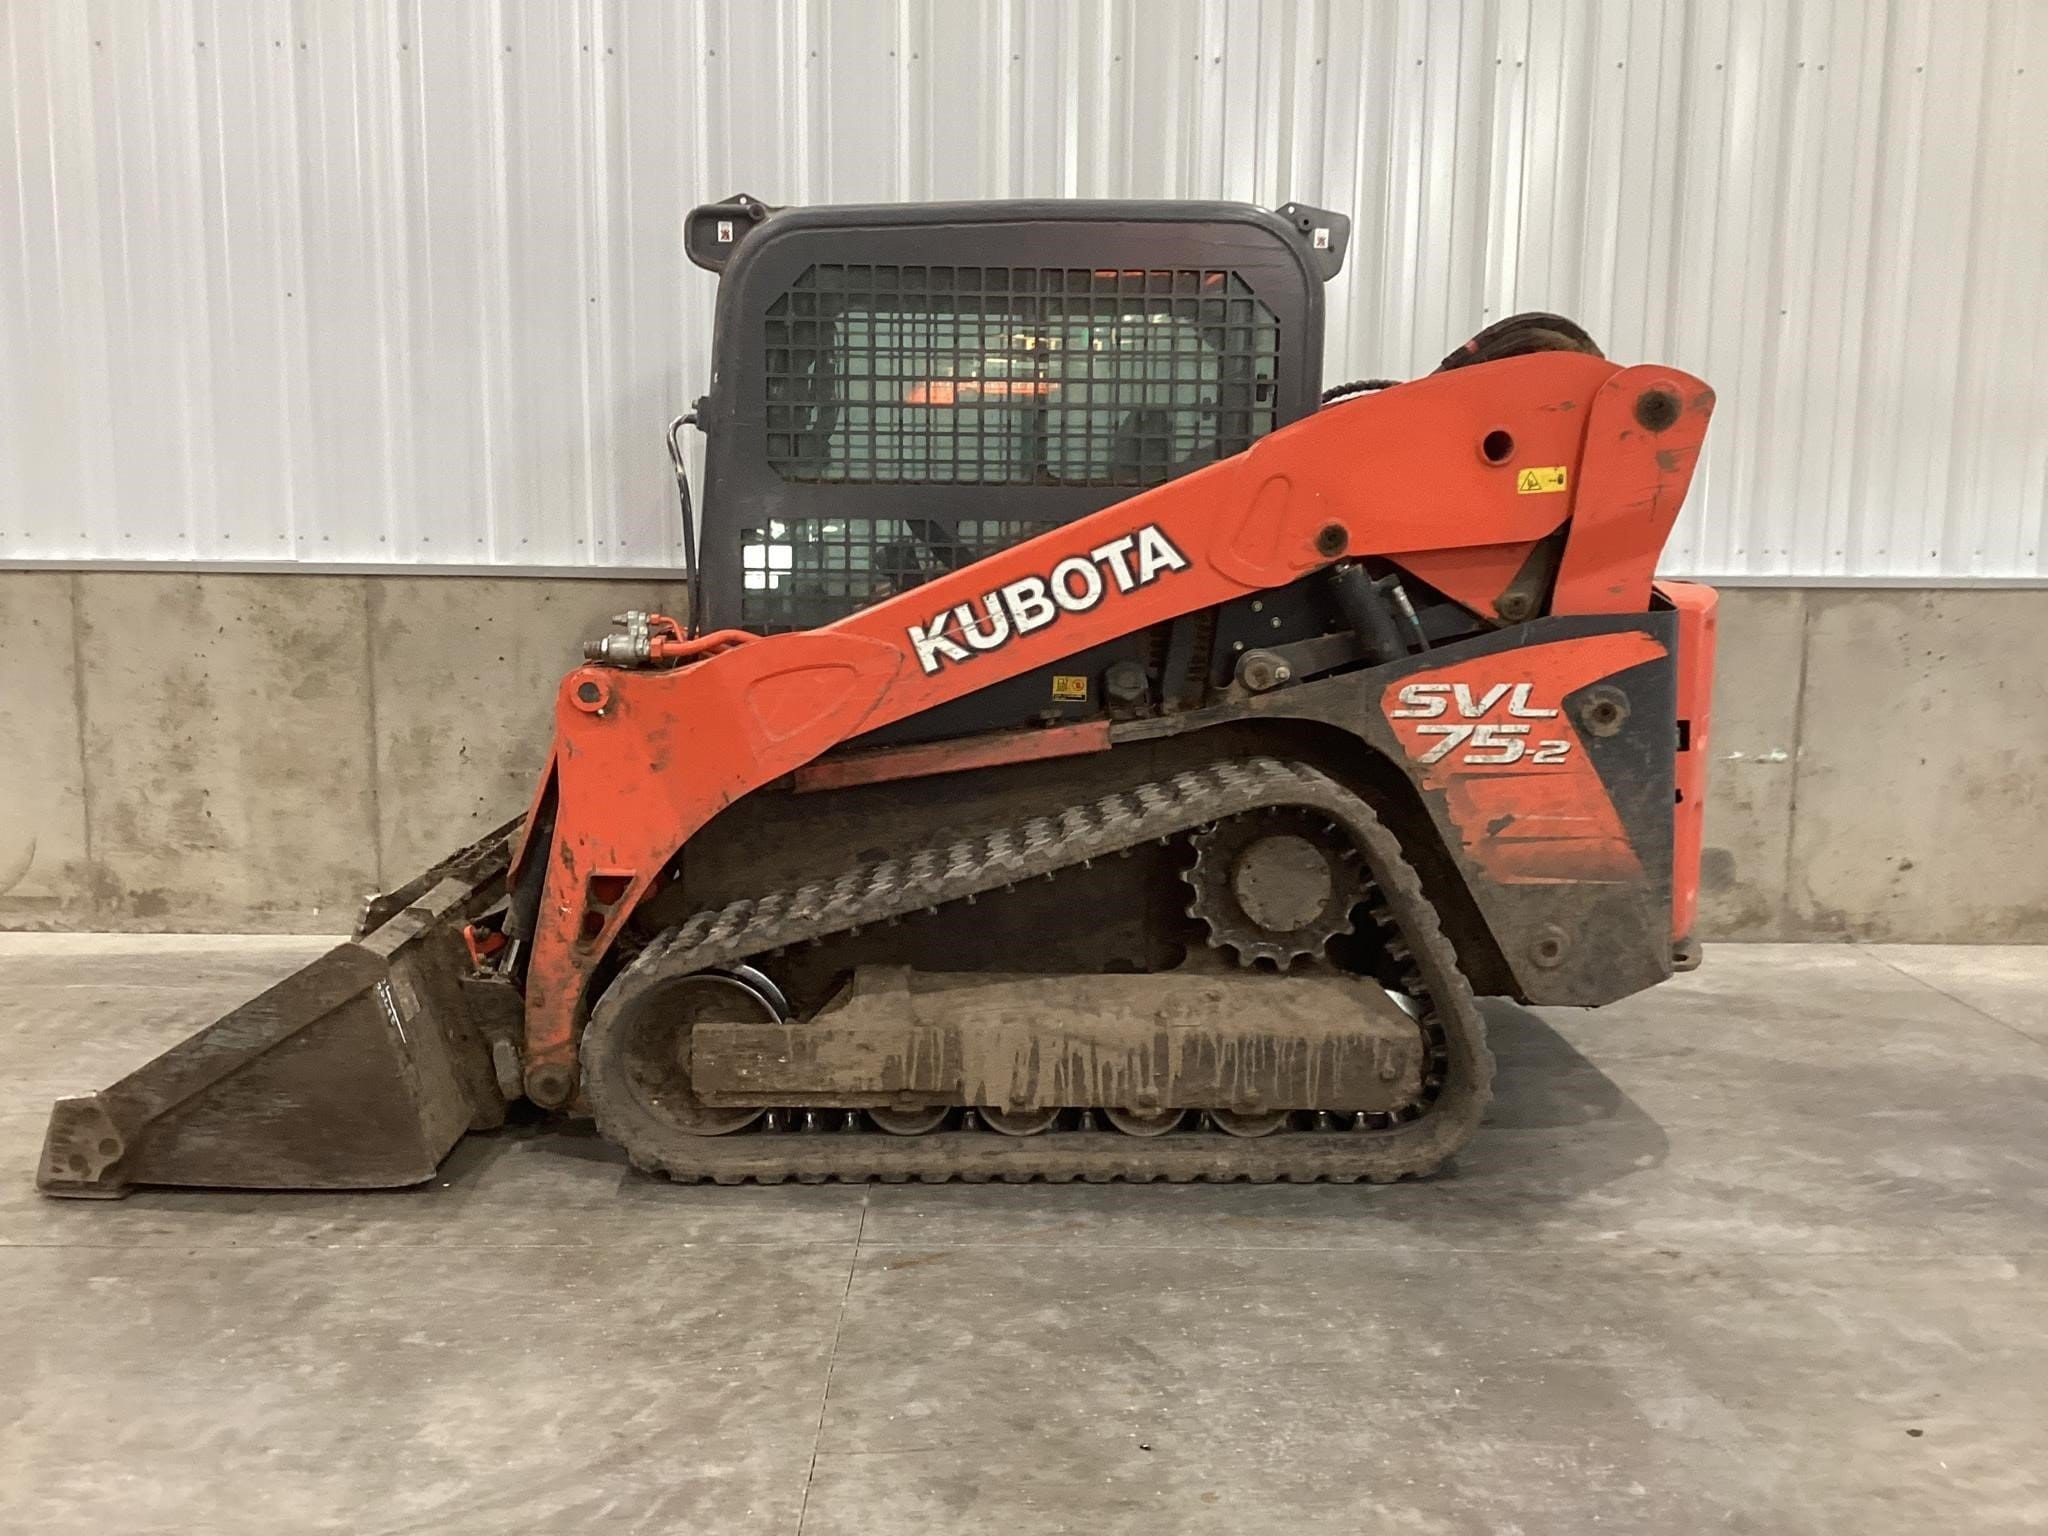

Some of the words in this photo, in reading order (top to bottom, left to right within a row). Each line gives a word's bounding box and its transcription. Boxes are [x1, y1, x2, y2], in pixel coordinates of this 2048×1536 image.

[907, 525, 1187, 674] KUBOTA
[1389, 683, 1559, 718] SVL
[1416, 724, 1571, 764] 75-2
